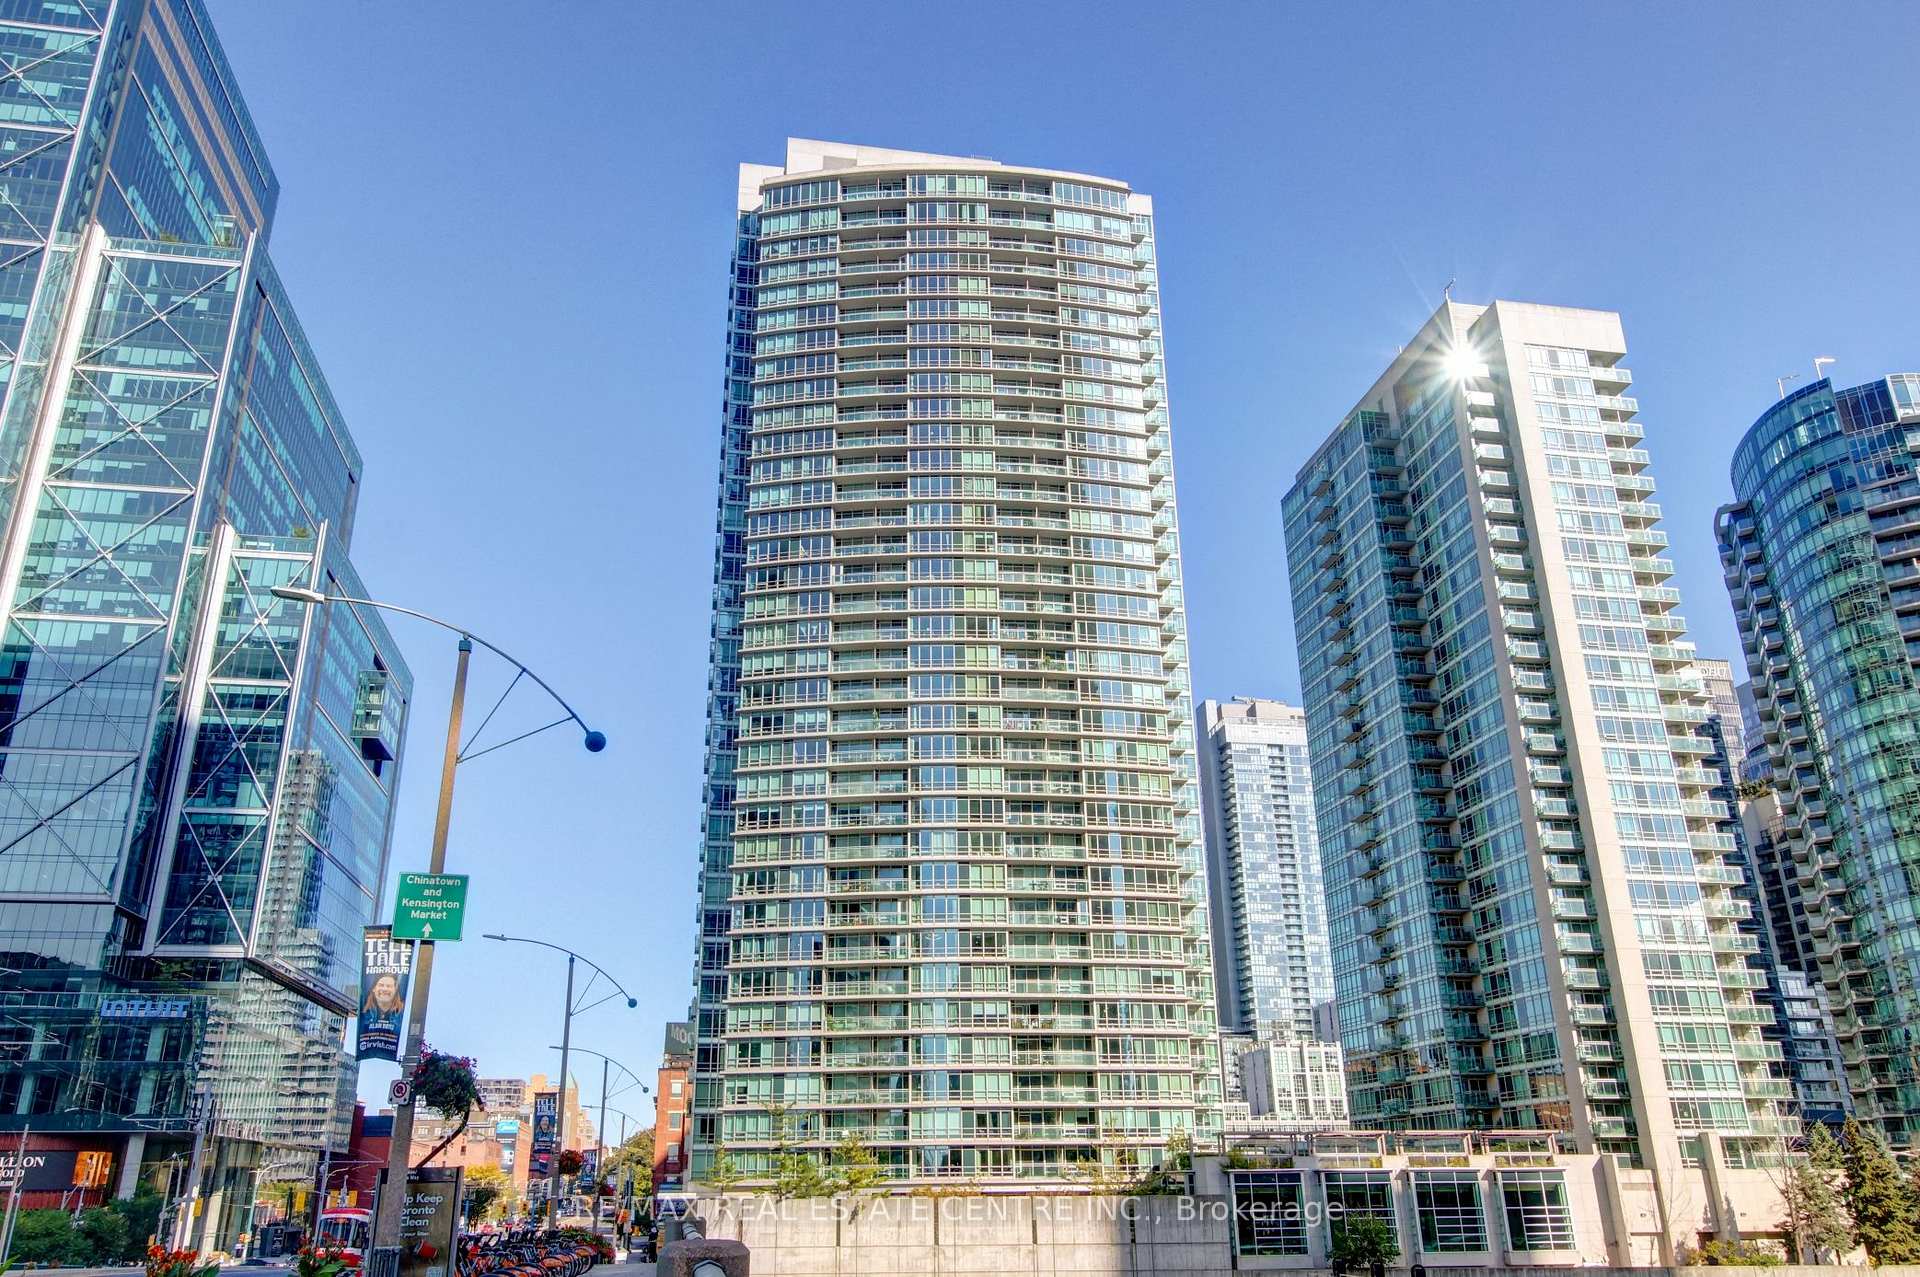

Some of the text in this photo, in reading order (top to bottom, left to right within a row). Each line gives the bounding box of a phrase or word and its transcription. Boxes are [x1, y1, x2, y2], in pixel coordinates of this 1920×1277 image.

[406, 875, 461, 886] Chinatown
[423, 888, 442, 896] and
[401, 898, 460, 910] Kensington
[410, 910, 448, 919] Market
[365, 938, 412, 952] TELL
[365, 952, 412, 966] TALE
[0, 1156, 46, 1168] LLON
[0, 1169, 25, 1178] OLD
[416, 1193, 443, 1206] Keep
[401, 1205, 436, 1215] oronto
